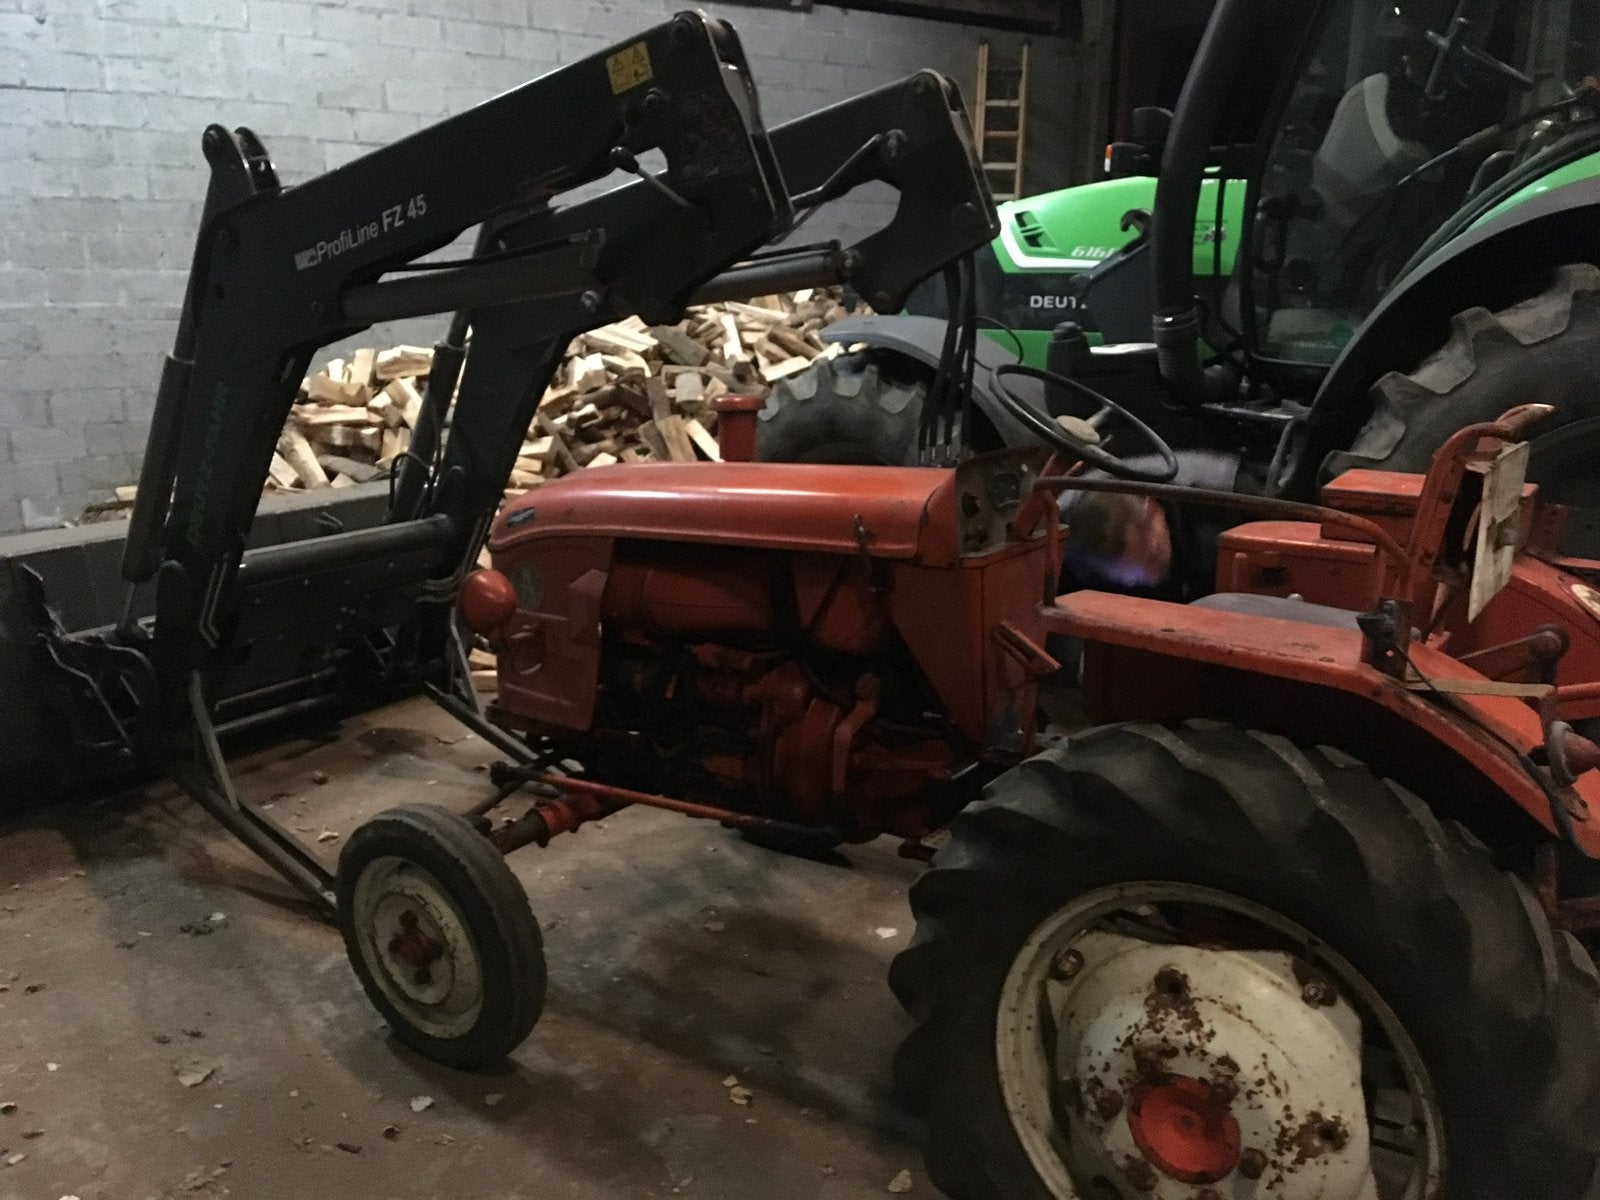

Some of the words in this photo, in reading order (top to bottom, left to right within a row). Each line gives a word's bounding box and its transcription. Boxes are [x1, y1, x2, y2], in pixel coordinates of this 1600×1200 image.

[316, 221, 379, 263] ProfiLine
[382, 204, 405, 232] FZ
[407, 193, 428, 219] 45
[1029, 295, 1088, 309] DEUT
